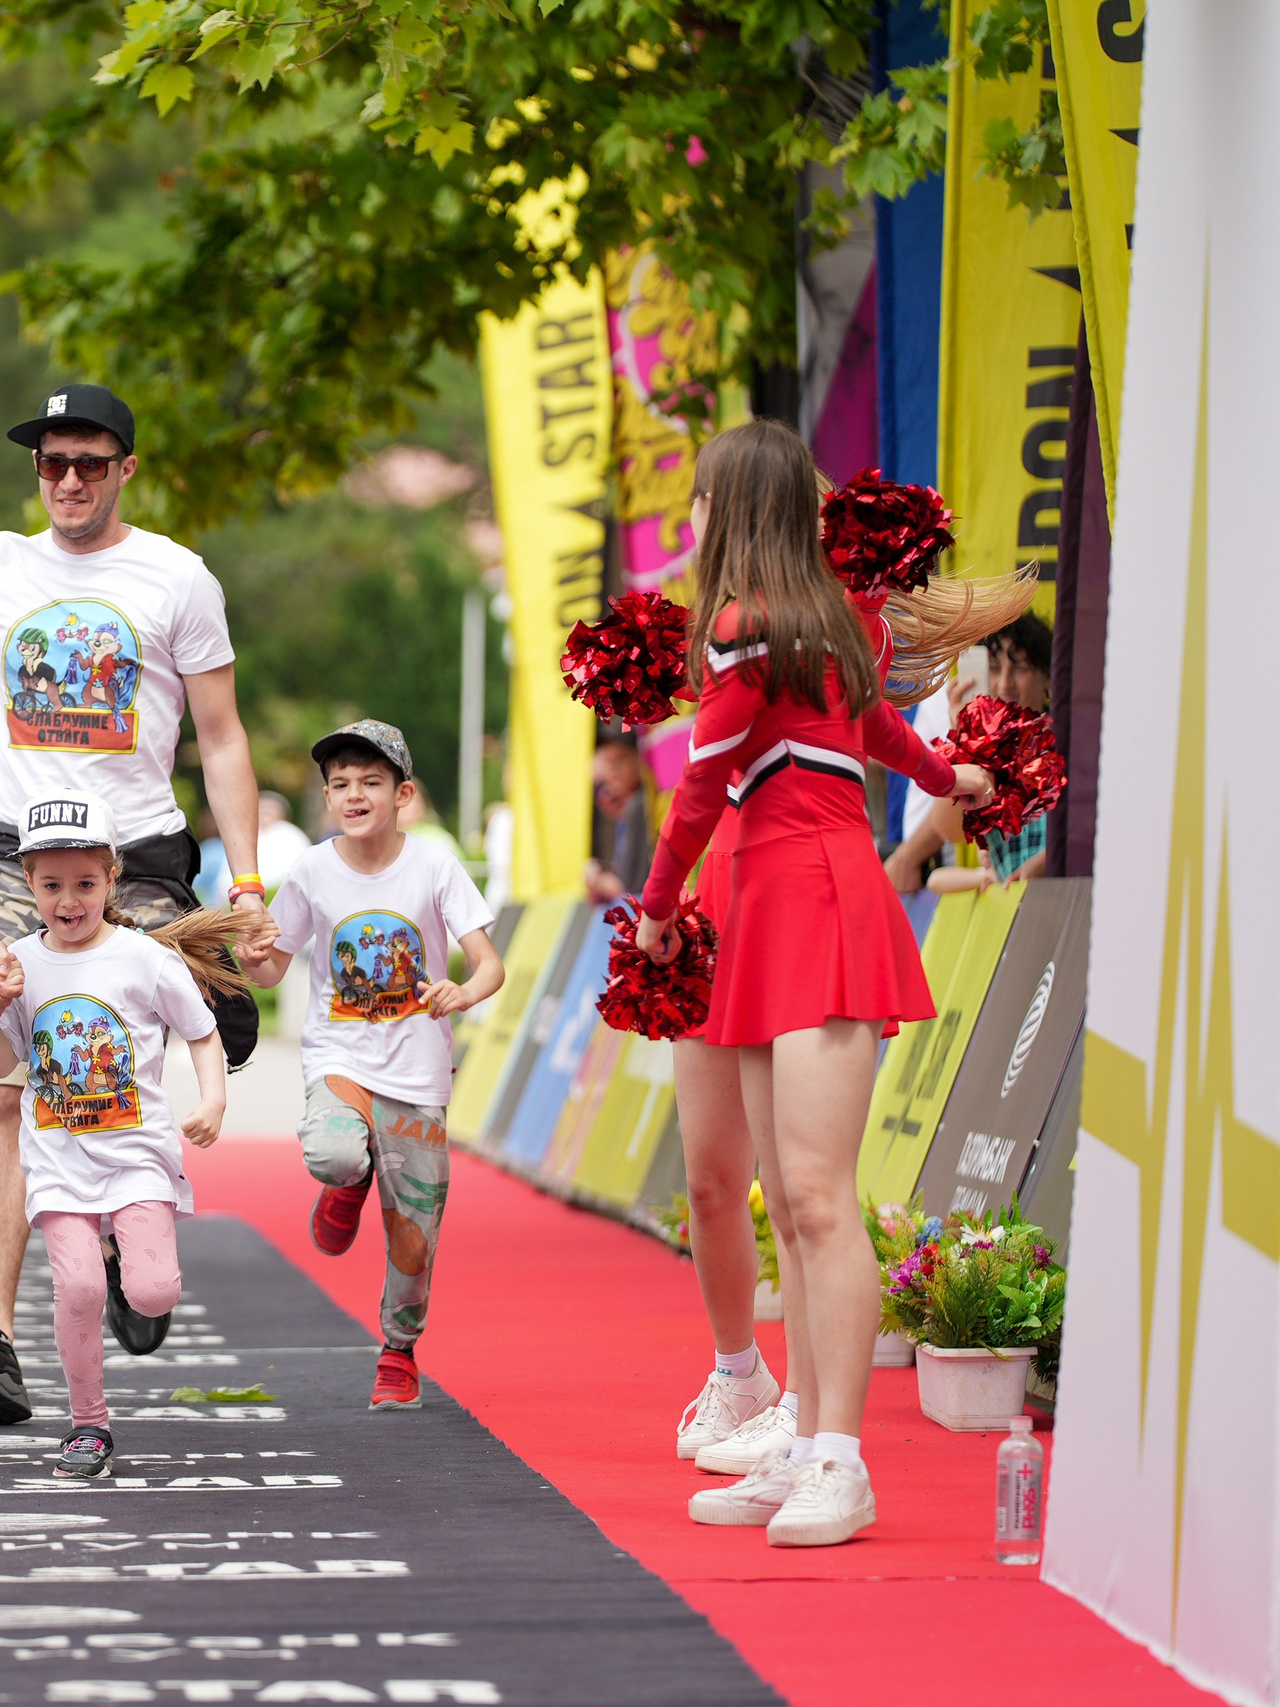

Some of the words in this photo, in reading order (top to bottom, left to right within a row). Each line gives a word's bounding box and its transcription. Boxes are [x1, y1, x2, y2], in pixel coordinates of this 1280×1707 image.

[535, 304, 597, 469] STAR
[30, 803, 86, 828] FUNNY
[13, 1475, 343, 1489] STAR
[29, 1558, 411, 1579] STAR
[44, 1679, 502, 1704] STAR
